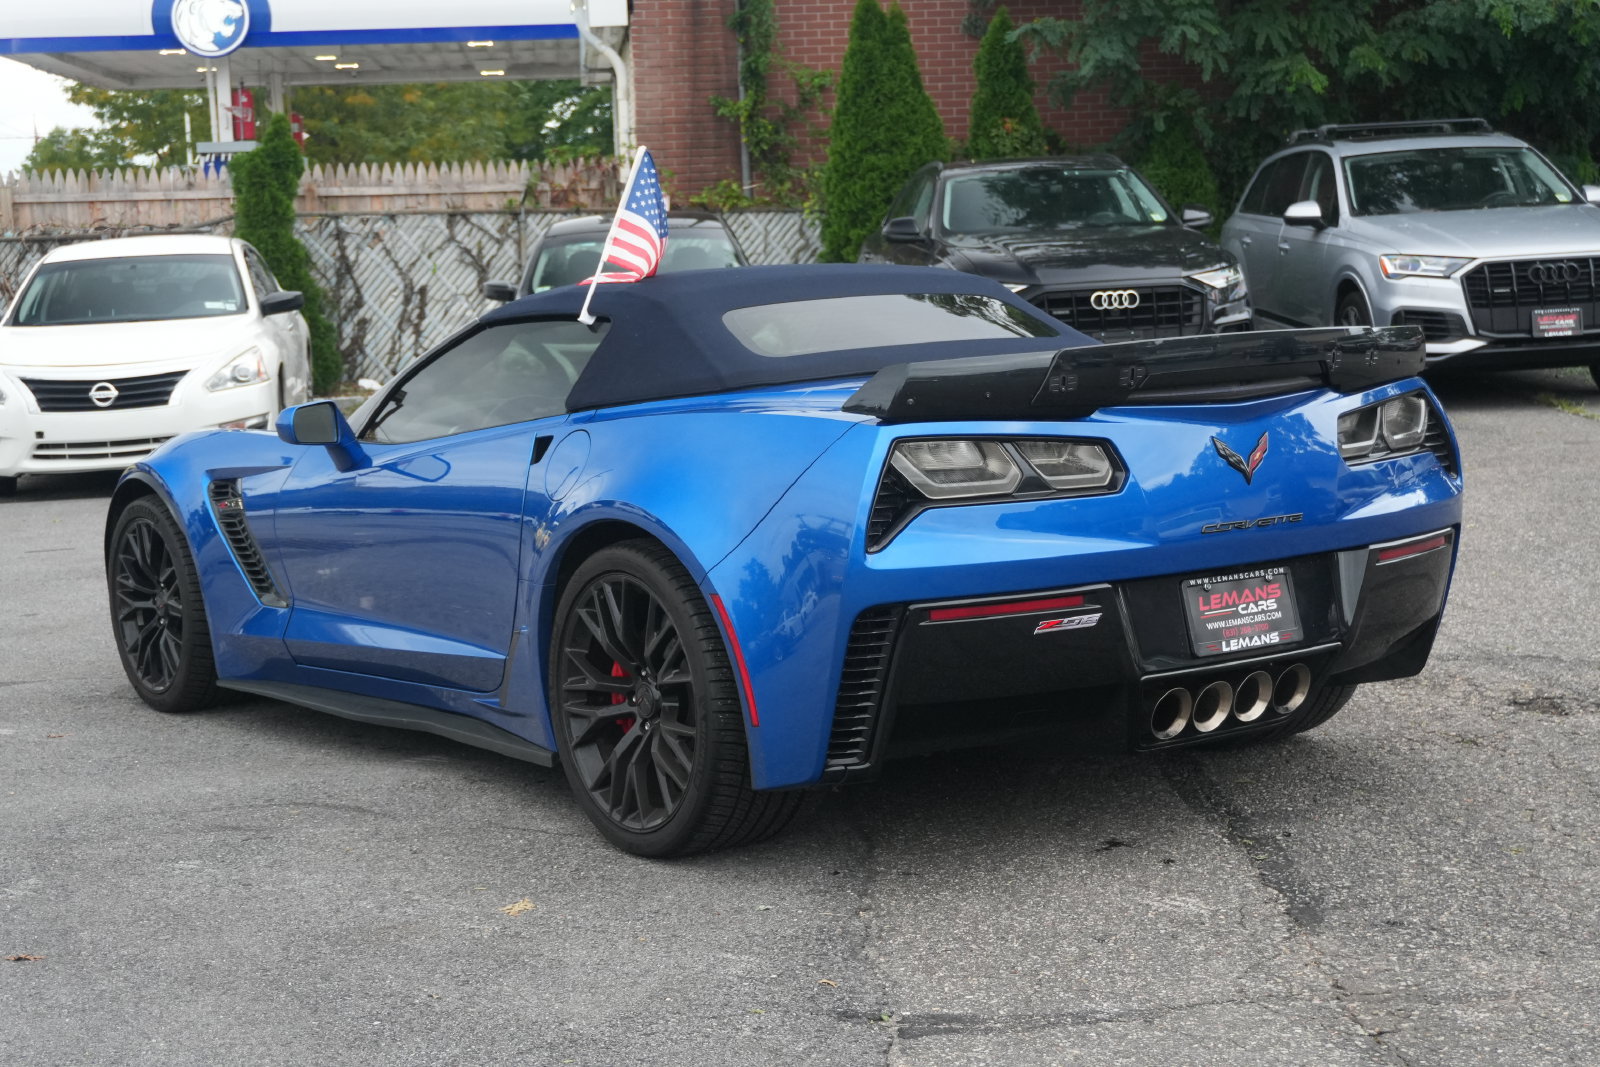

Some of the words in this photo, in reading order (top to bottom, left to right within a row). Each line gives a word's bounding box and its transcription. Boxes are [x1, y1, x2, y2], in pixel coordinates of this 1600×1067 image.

[1201, 512, 1303, 534] CORVETTE
[1189, 567, 1284, 586] WWW.LEMANSCARS.COM
[1199, 583, 1281, 611] LEMANS
[1238, 598, 1277, 614] CARS
[1206, 611, 1281, 630] WWW.LEMANSCARS.COM
[1221, 632, 1280, 652] LEMANS
